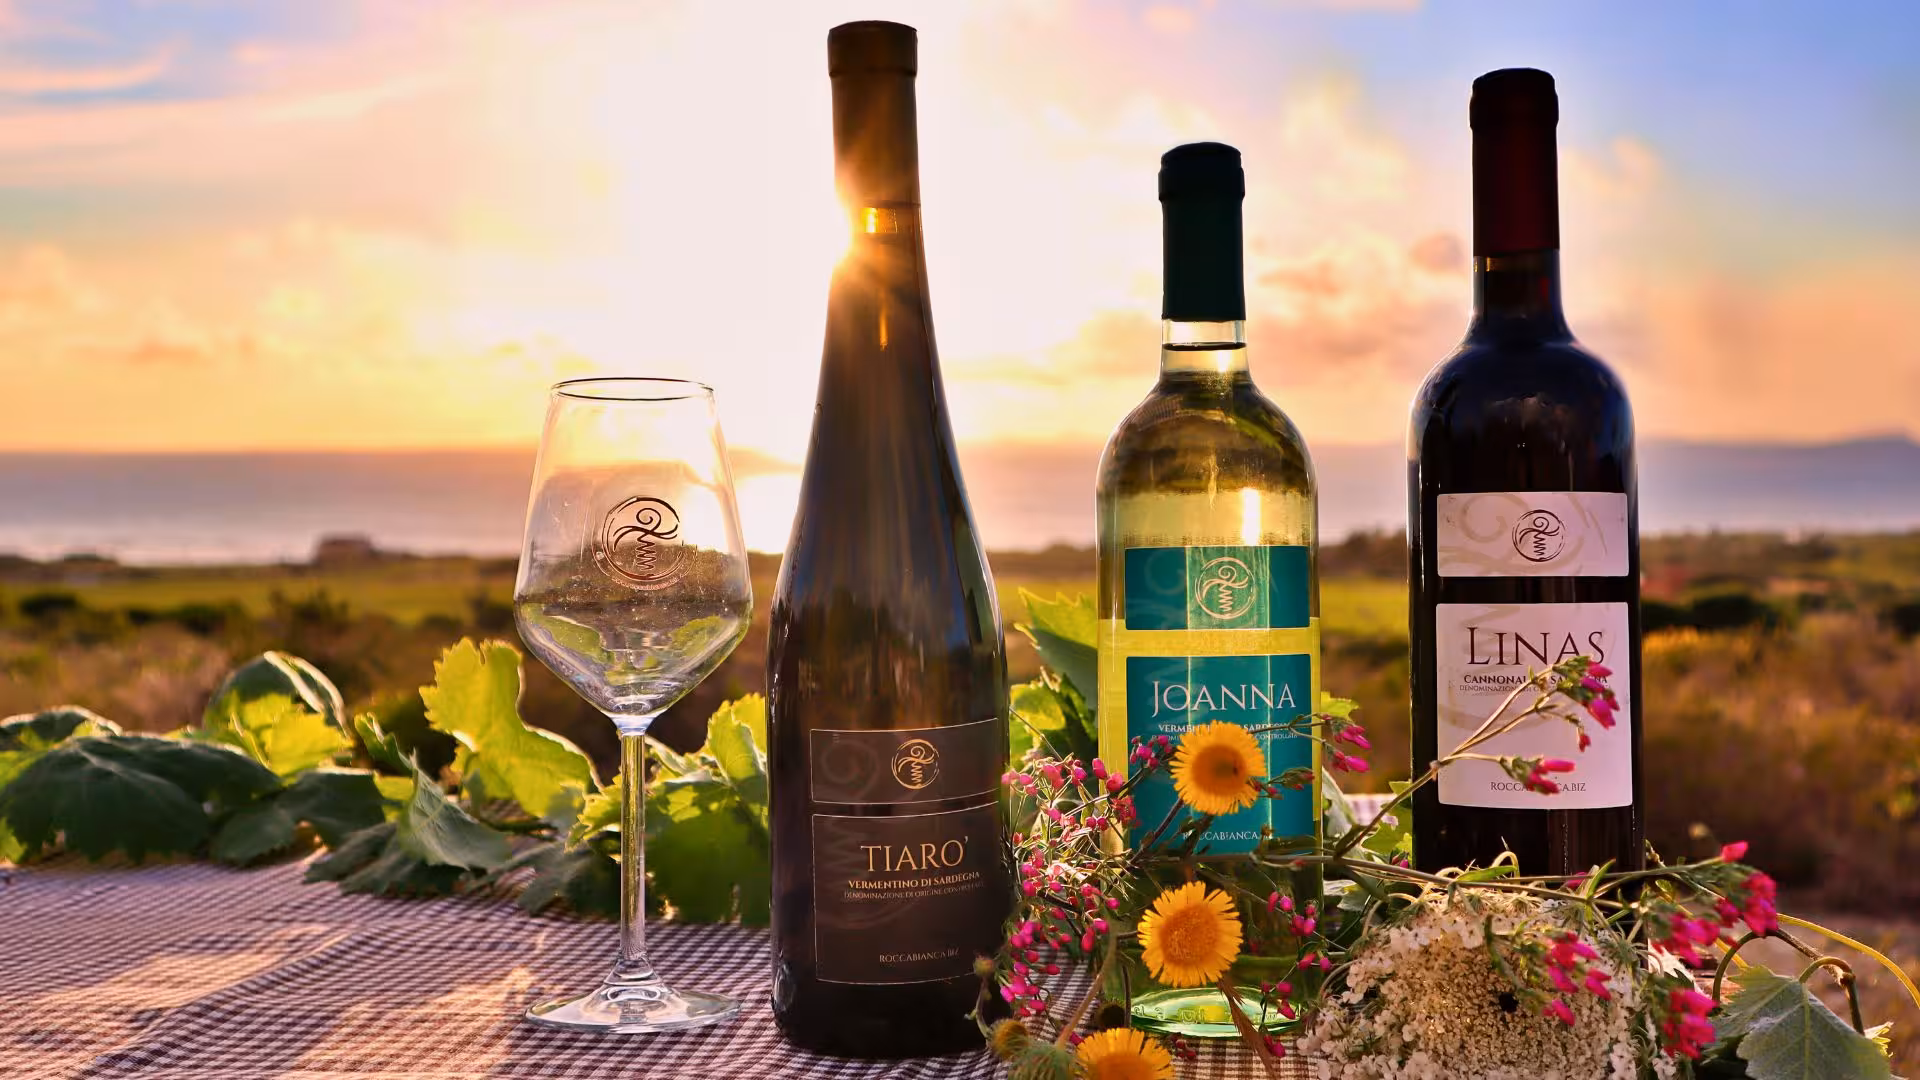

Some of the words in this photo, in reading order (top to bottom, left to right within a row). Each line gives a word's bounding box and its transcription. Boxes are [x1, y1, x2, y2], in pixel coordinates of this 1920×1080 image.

[1467, 626, 1605, 666] LINAS
[1151, 680, 1297, 718] JOANNA
[848, 879, 919, 889] VERMENTINO
[920, 878, 932, 887] DI
[933, 871, 980, 885] SARDEGNA
